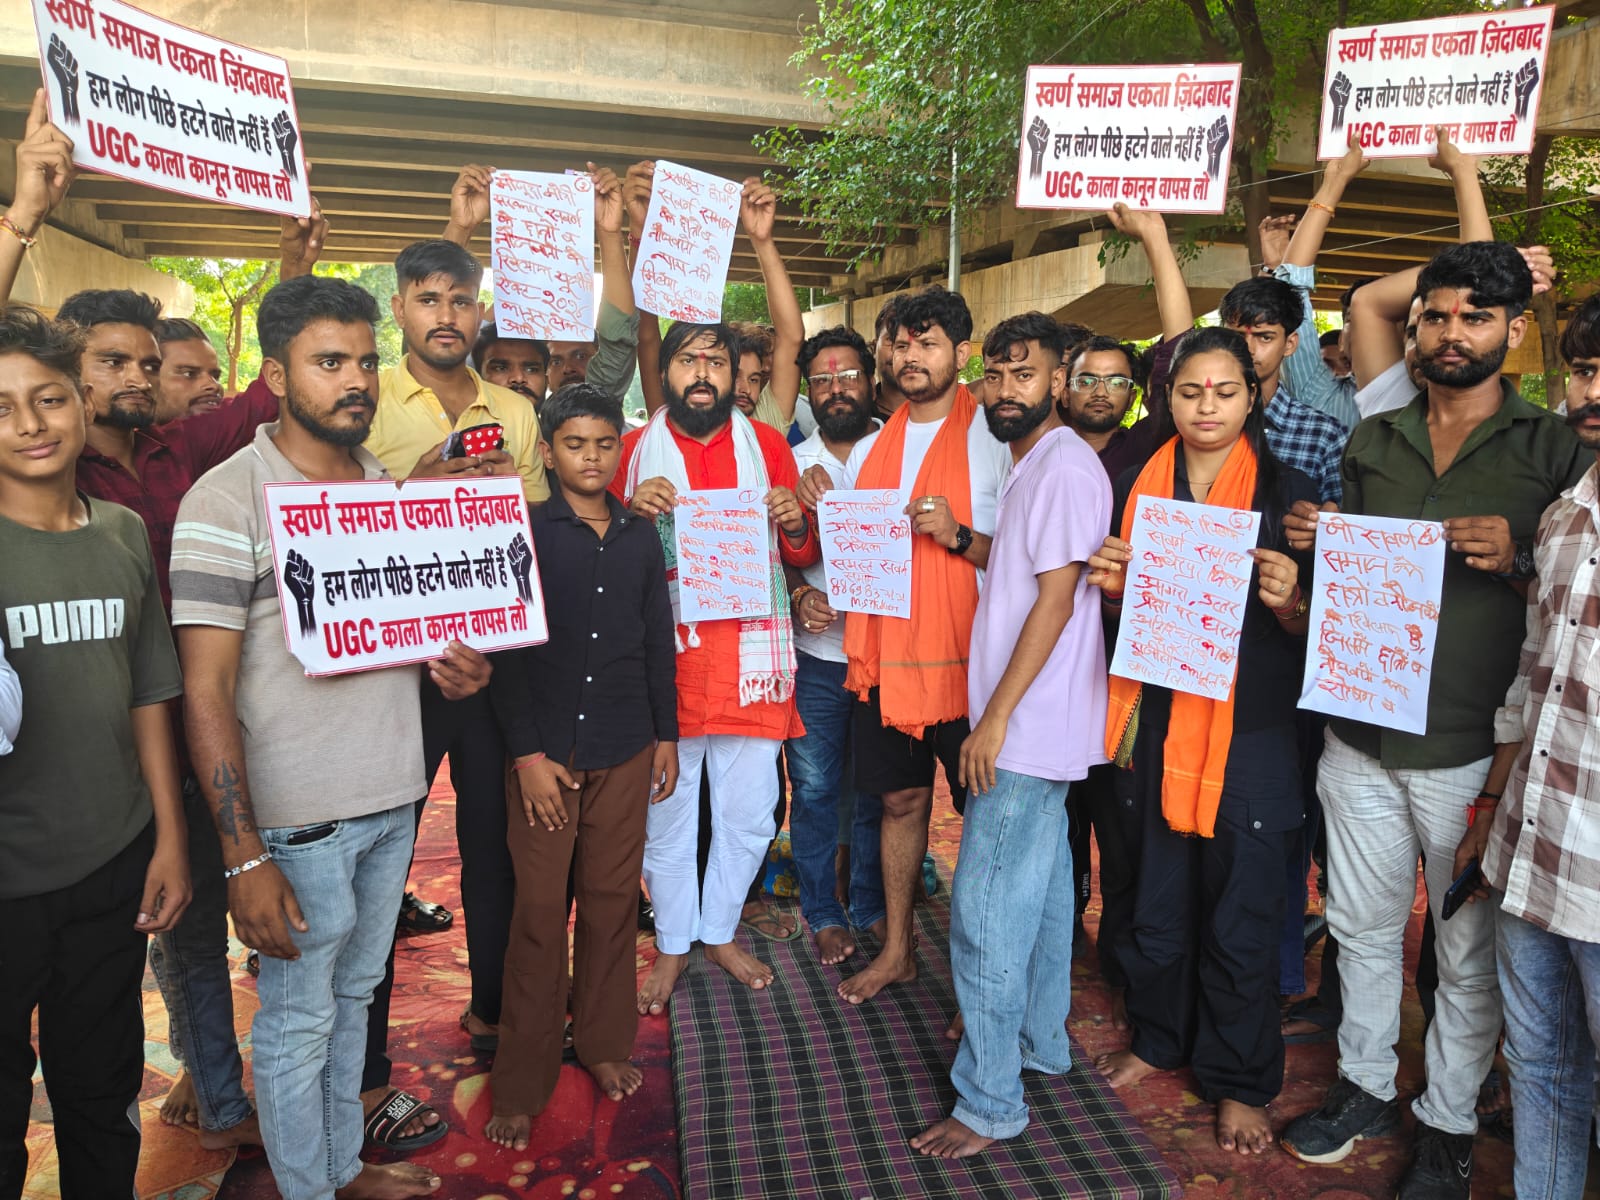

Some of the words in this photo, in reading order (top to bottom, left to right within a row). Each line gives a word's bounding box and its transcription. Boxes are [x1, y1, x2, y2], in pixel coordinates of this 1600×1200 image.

[100, 12, 161, 65] समाज
[164, 39, 217, 83] एकता
[1338, 29, 1377, 63] स्वर्ण
[1380, 34, 1428, 60] समाज
[1432, 30, 1478, 57] एकता
[1036, 73, 1075, 107] स्वर्ण
[1077, 82, 1124, 108] समाज
[1127, 82, 1171, 107] एकता
[1355, 87, 1373, 111] हम
[1376, 79, 1401, 108] लोग
[1403, 76, 1425, 106] पीछे
[1428, 75, 1453, 108] हटने
[1455, 74, 1479, 107] वाले
[1480, 72, 1502, 103] नहीं
[1501, 70, 1513, 105] हैं
[86, 71, 109, 109] हम
[113, 75, 146, 120] लोग
[147, 86, 176, 128] पीछे
[178, 100, 207, 138] हटने
[209, 107, 236, 144] वाले
[237, 114, 260, 150] नहीं
[260, 116, 271, 156] हैं
[1389, 124, 1422, 145] काला
[1464, 121, 1498, 143] वापस
[1499, 114, 1517, 142] लो
[87, 120, 140, 168] UGC
[143, 143, 185, 179] काला
[188, 155, 229, 198] कानून
[232, 166, 271, 199] वापस
[273, 170, 292, 202] लो
[1054, 134, 1072, 159] हम
[1074, 127, 1099, 157] लोग
[1100, 126, 1123, 158] पीछे
[1125, 127, 1149, 161] हटने
[1151, 127, 1173, 158] वाले
[1174, 127, 1195, 161] नहीं
[1195, 126, 1205, 161] हैं
[1045, 171, 1083, 198] UGC
[1087, 176, 1120, 198] काला
[1122, 177, 1157, 206] कानून
[1159, 178, 1191, 200] वापस
[1193, 172, 1210, 200] लो
[280, 491, 332, 538] स्वर्ण
[335, 500, 398, 534] समाज
[400, 498, 454, 530] एकता
[322, 570, 348, 606] हम
[349, 558, 382, 599] लोग
[382, 555, 412, 596] पीछे
[414, 552, 444, 595] हटने
[446, 550, 473, 590] वाले
[473, 548, 496, 588] नहीं
[496, 546, 508, 587] हैं
[5, 599, 124, 648] PUMA
[324, 618, 378, 659] UGC
[379, 618, 423, 648] काला
[469, 608, 507, 636] वापस
[509, 598, 527, 631] लो
[387, 1094, 407, 1115] JUST
[392, 1100, 414, 1119] RISE
